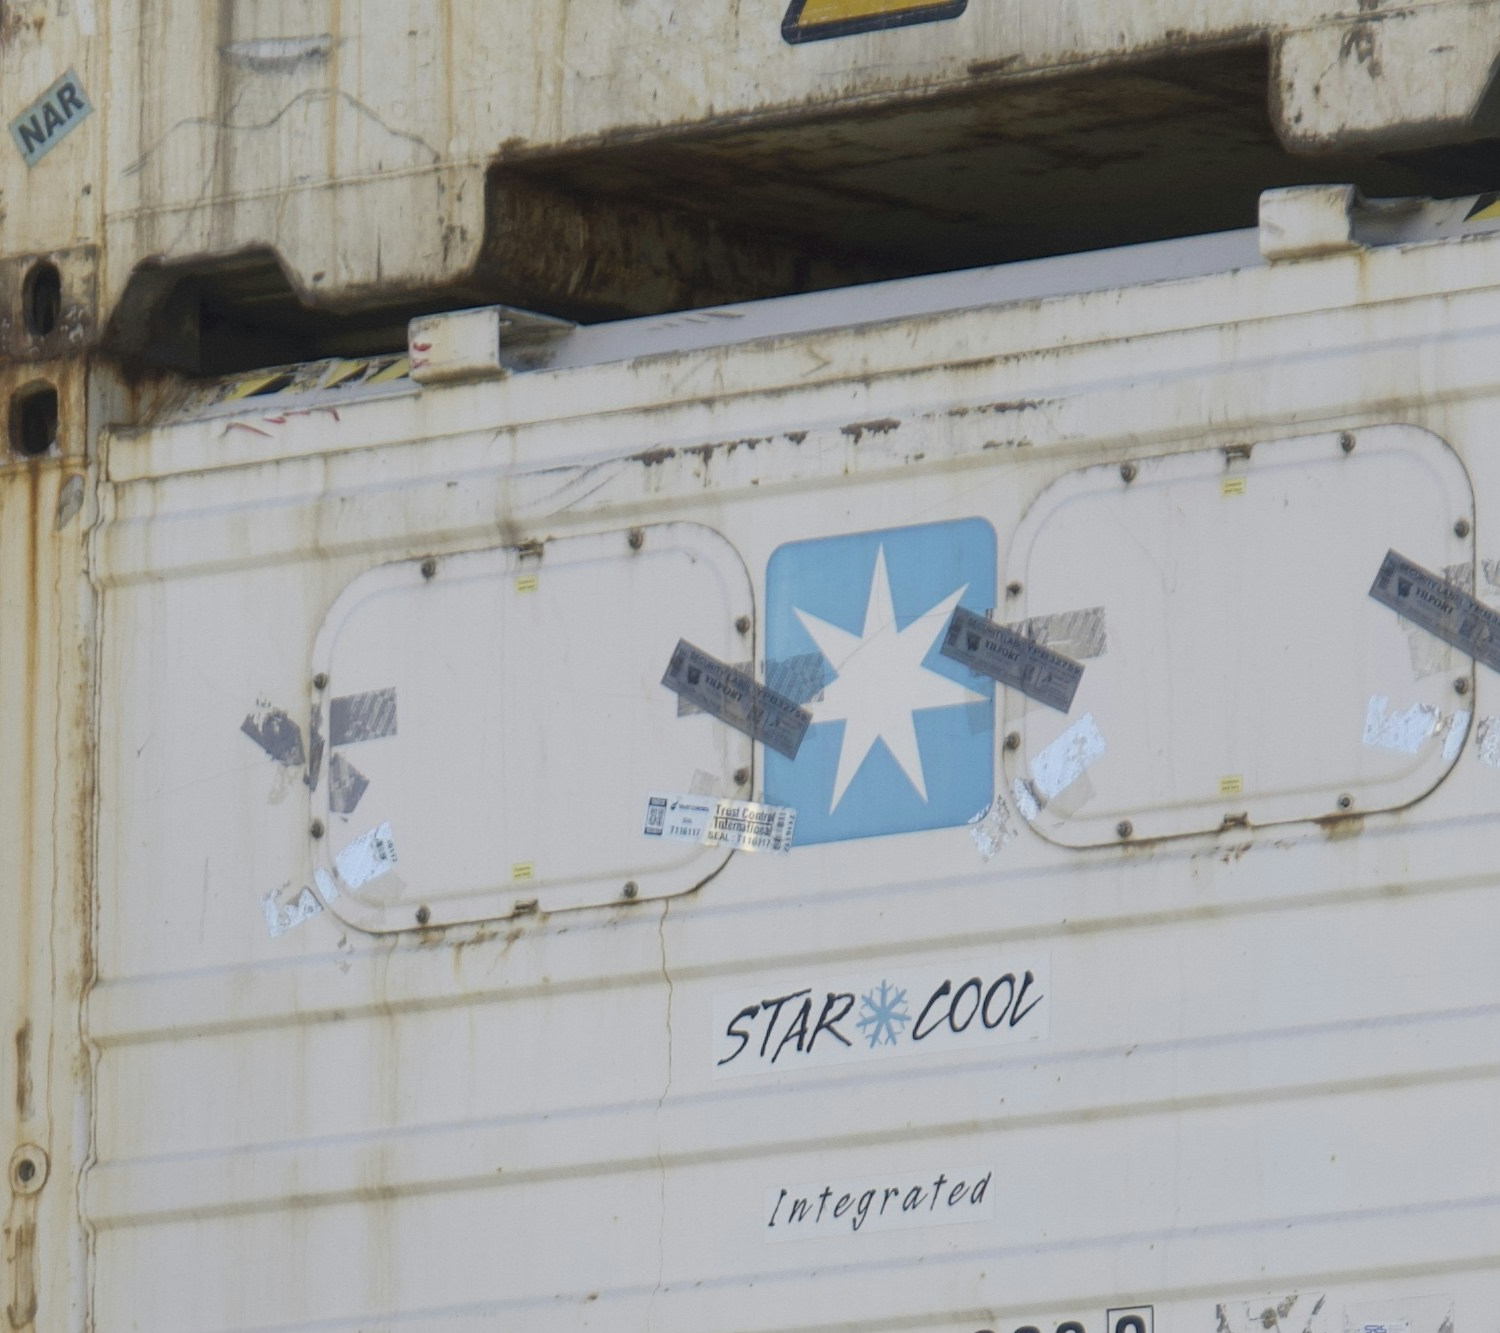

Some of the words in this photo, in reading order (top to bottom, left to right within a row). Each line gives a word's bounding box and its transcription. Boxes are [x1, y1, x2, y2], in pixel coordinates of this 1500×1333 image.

[17, 80, 86, 155] NAR
[725, 990, 855, 1067] STAR
[914, 967, 1047, 1042] COOL
[767, 1170, 993, 1232] Integrated
